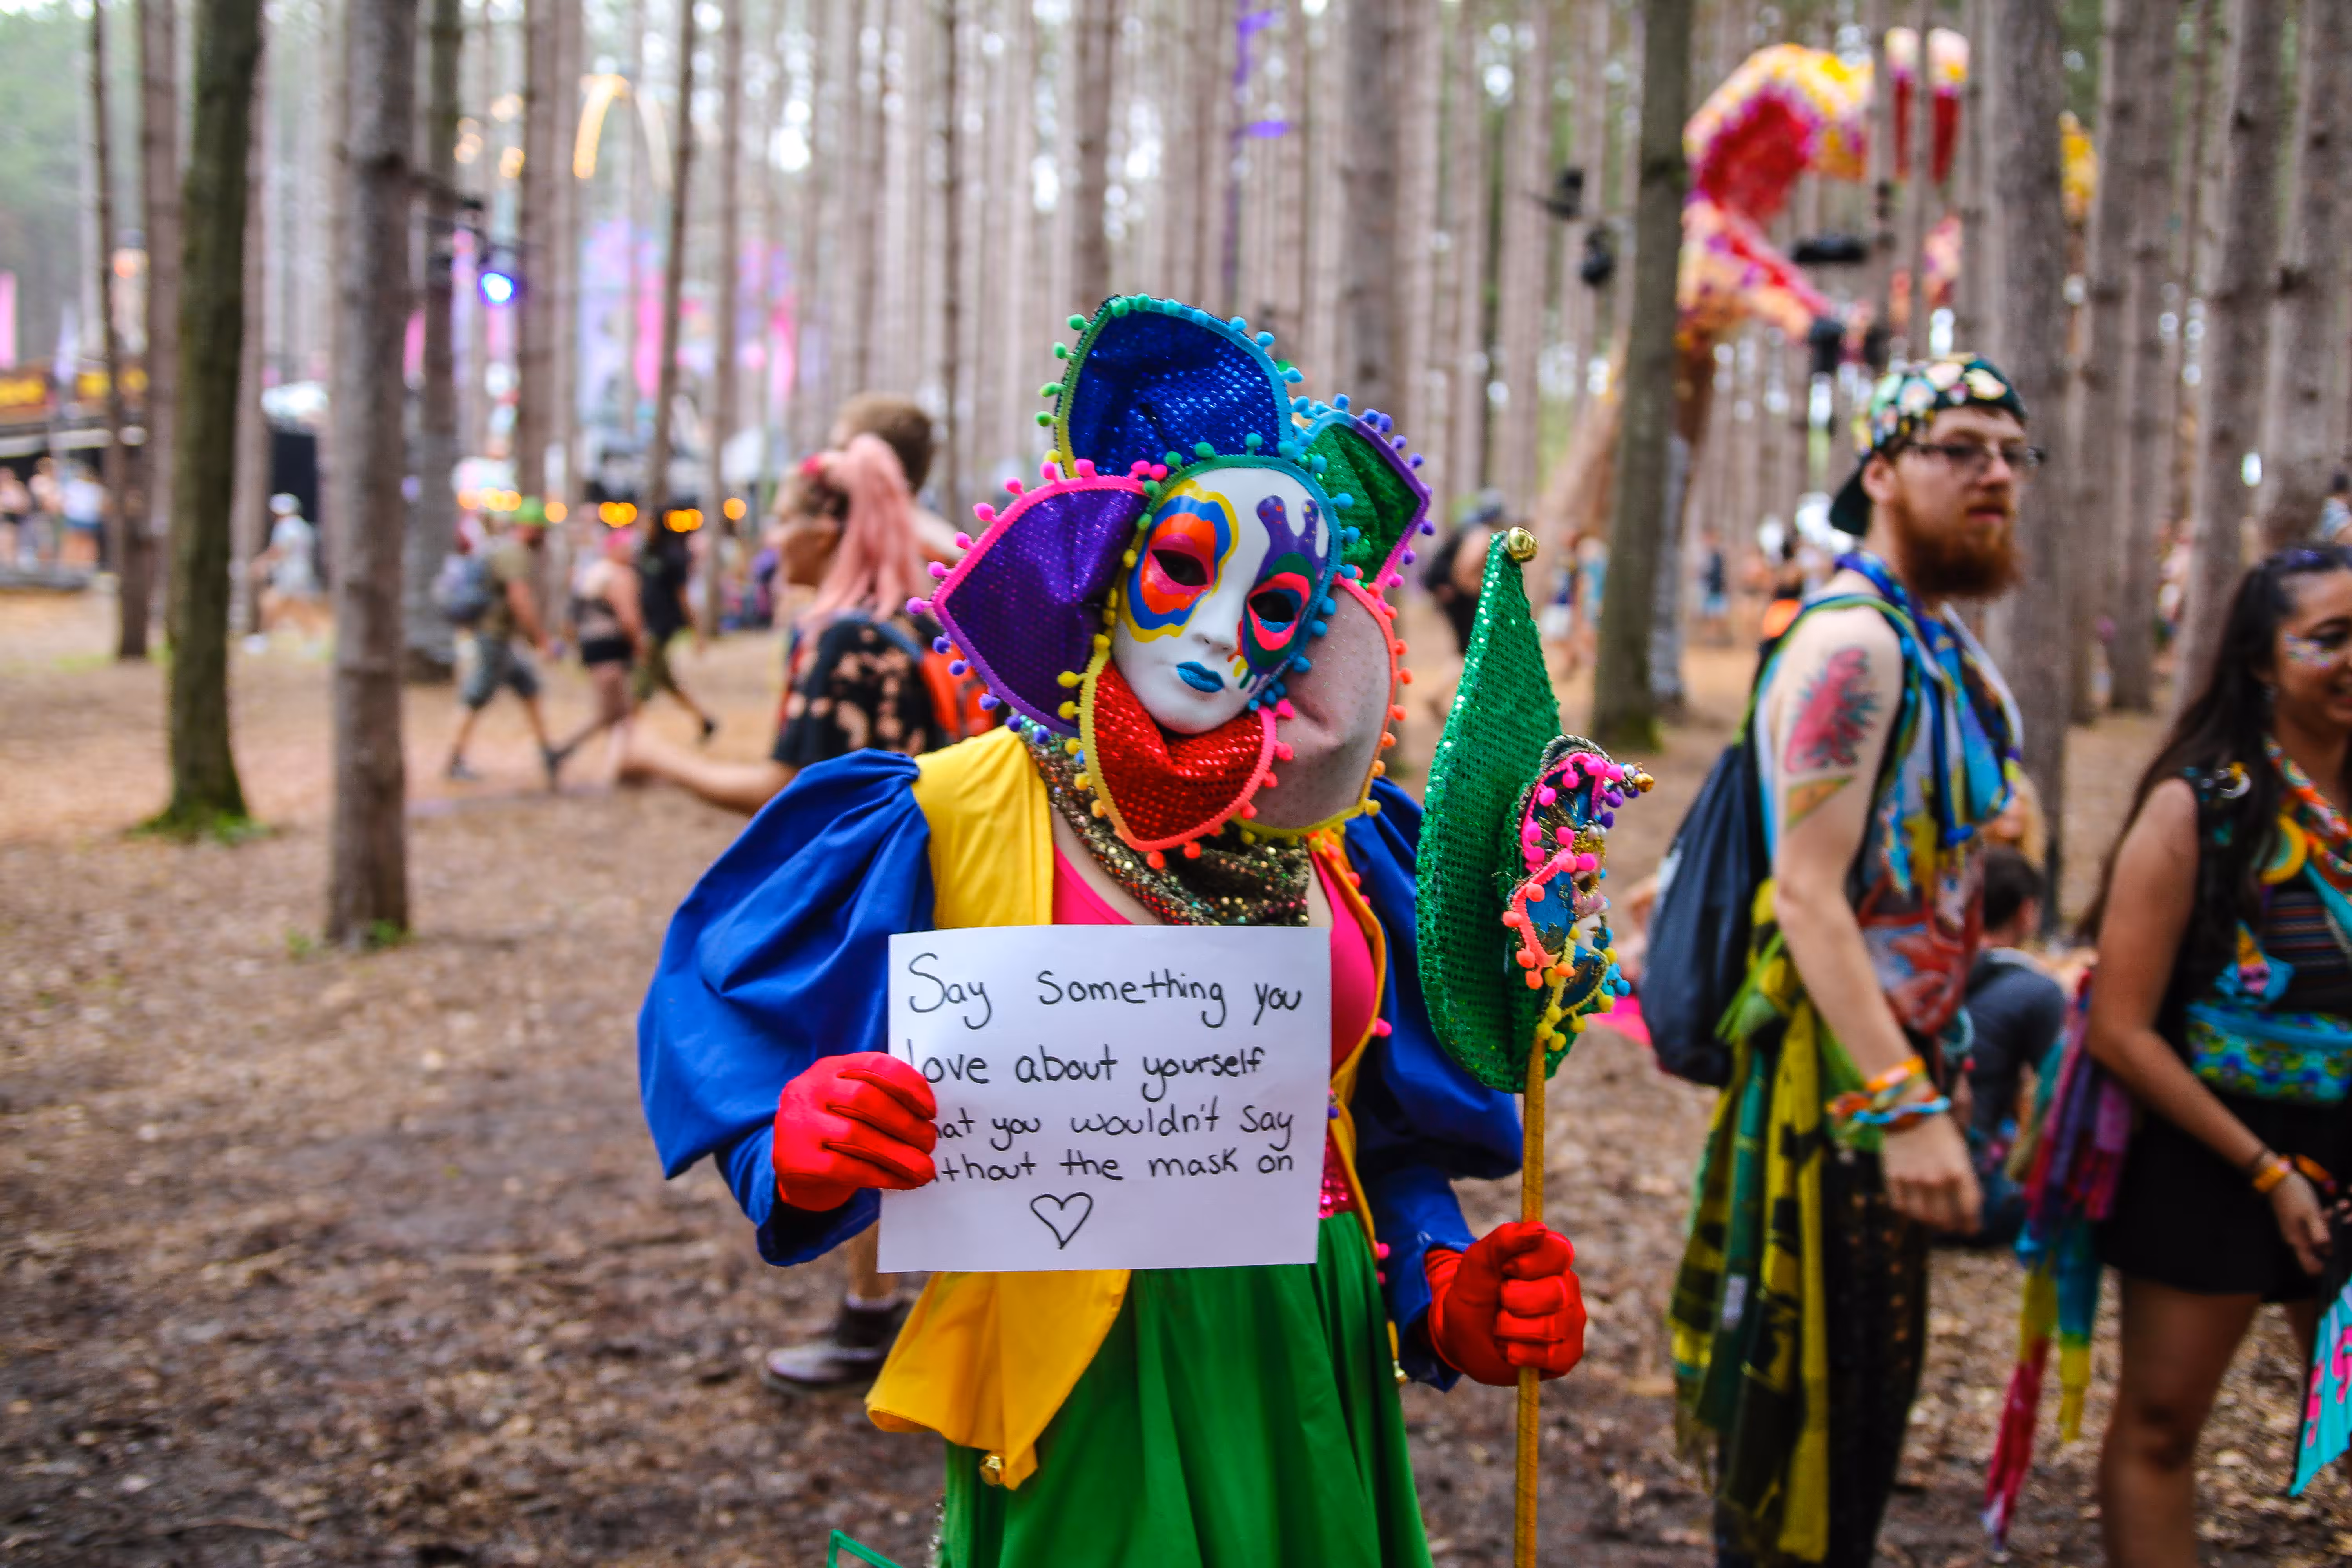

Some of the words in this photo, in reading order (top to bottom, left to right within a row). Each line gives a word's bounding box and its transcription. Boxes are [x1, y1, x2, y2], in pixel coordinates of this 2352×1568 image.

[908, 951, 993, 1031] Say
[1252, 981, 1303, 1026] you
[907, 1038, 991, 1085] love
[1014, 1044, 1119, 1084] about
[1140, 1046, 1266, 1103] yourself
[989, 1117, 1042, 1152] you
[1070, 1096, 1220, 1137] wouldn't
[934, 1151, 1038, 1183] thout
[1058, 1148, 1124, 1181] the
[1256, 1153, 1294, 1175] on
